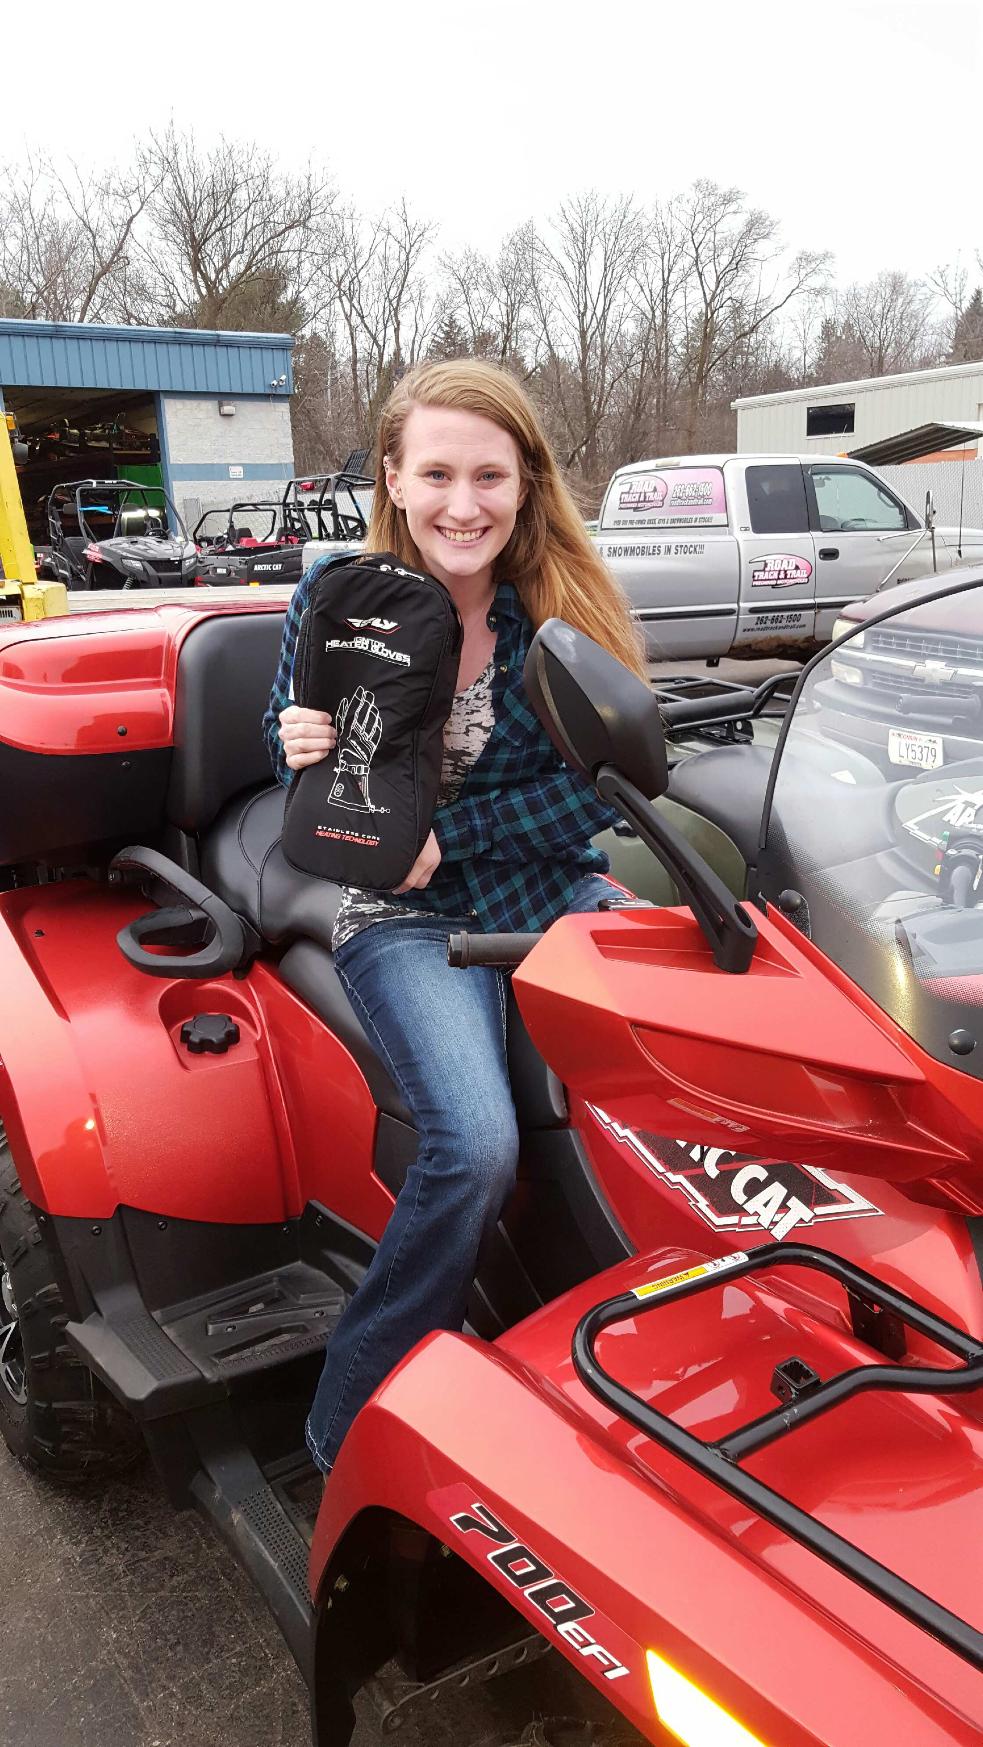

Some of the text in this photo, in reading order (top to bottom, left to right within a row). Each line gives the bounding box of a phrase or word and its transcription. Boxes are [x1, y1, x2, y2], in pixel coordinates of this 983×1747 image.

[631, 480, 656, 493] ROAD
[620, 493, 640, 502] TRACK
[645, 492, 663, 501] TRAIL
[607, 545, 661, 557] SNOWMOBILES
[664, 545, 672, 555] IN
[674, 544, 705, 555] STOCK!!!
[764, 559, 796, 571] ROAD
[753, 569, 808, 580] TRACK & TRAIL
[755, 613, 802, 626] 262-662-1500
[326, 639, 411, 662] HEATED GLOVES
[898, 741, 937, 764] LY5379
[315, 830, 379, 847] HEATING TECHNOLOGY
[317, 825, 380, 841] STAINLESS CORE
[730, 1164, 816, 1242] CAT
